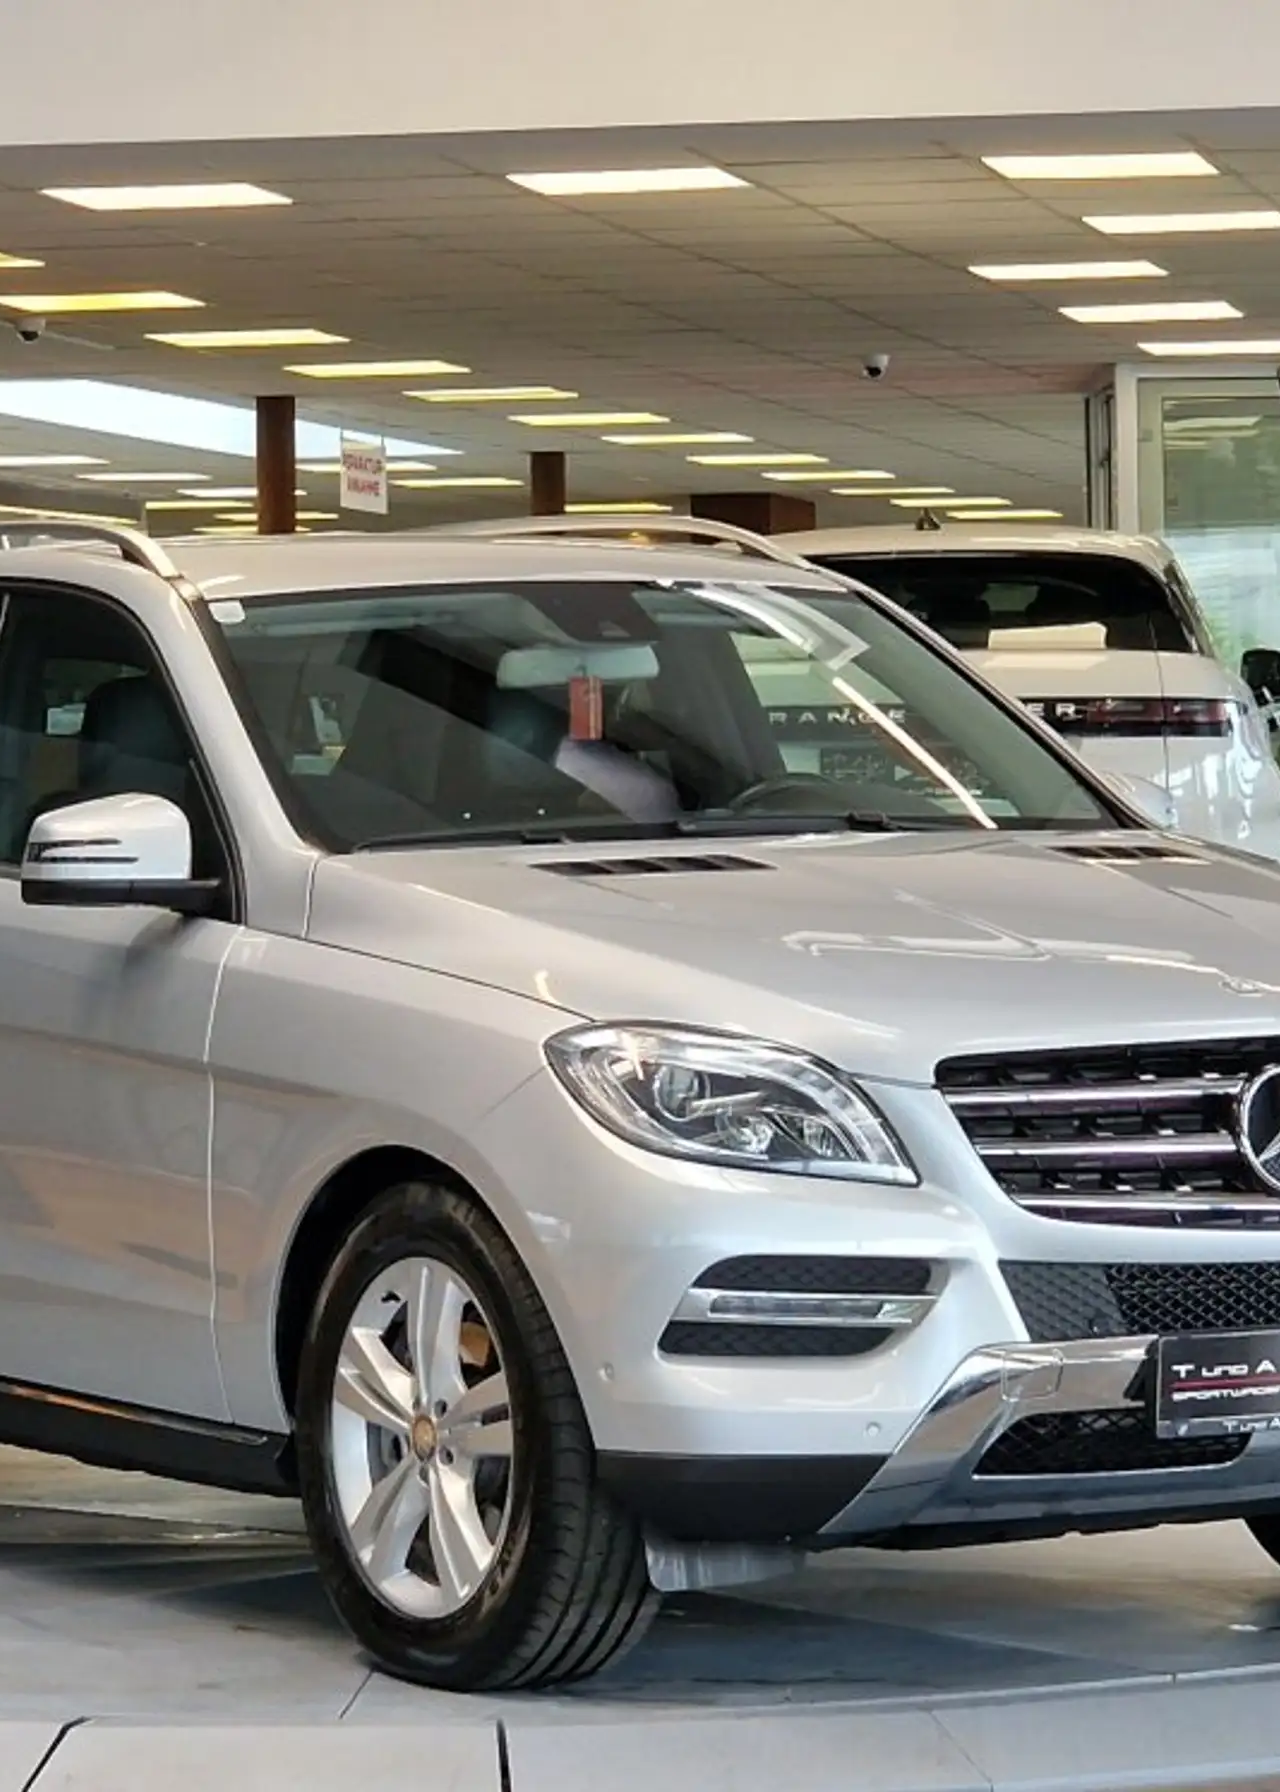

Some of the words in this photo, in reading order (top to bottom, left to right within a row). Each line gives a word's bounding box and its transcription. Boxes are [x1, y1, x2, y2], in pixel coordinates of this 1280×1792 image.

[1171, 1364, 1195, 1379] T
[1256, 1359, 1277, 1374] A
[1222, 1418, 1237, 1433] T
